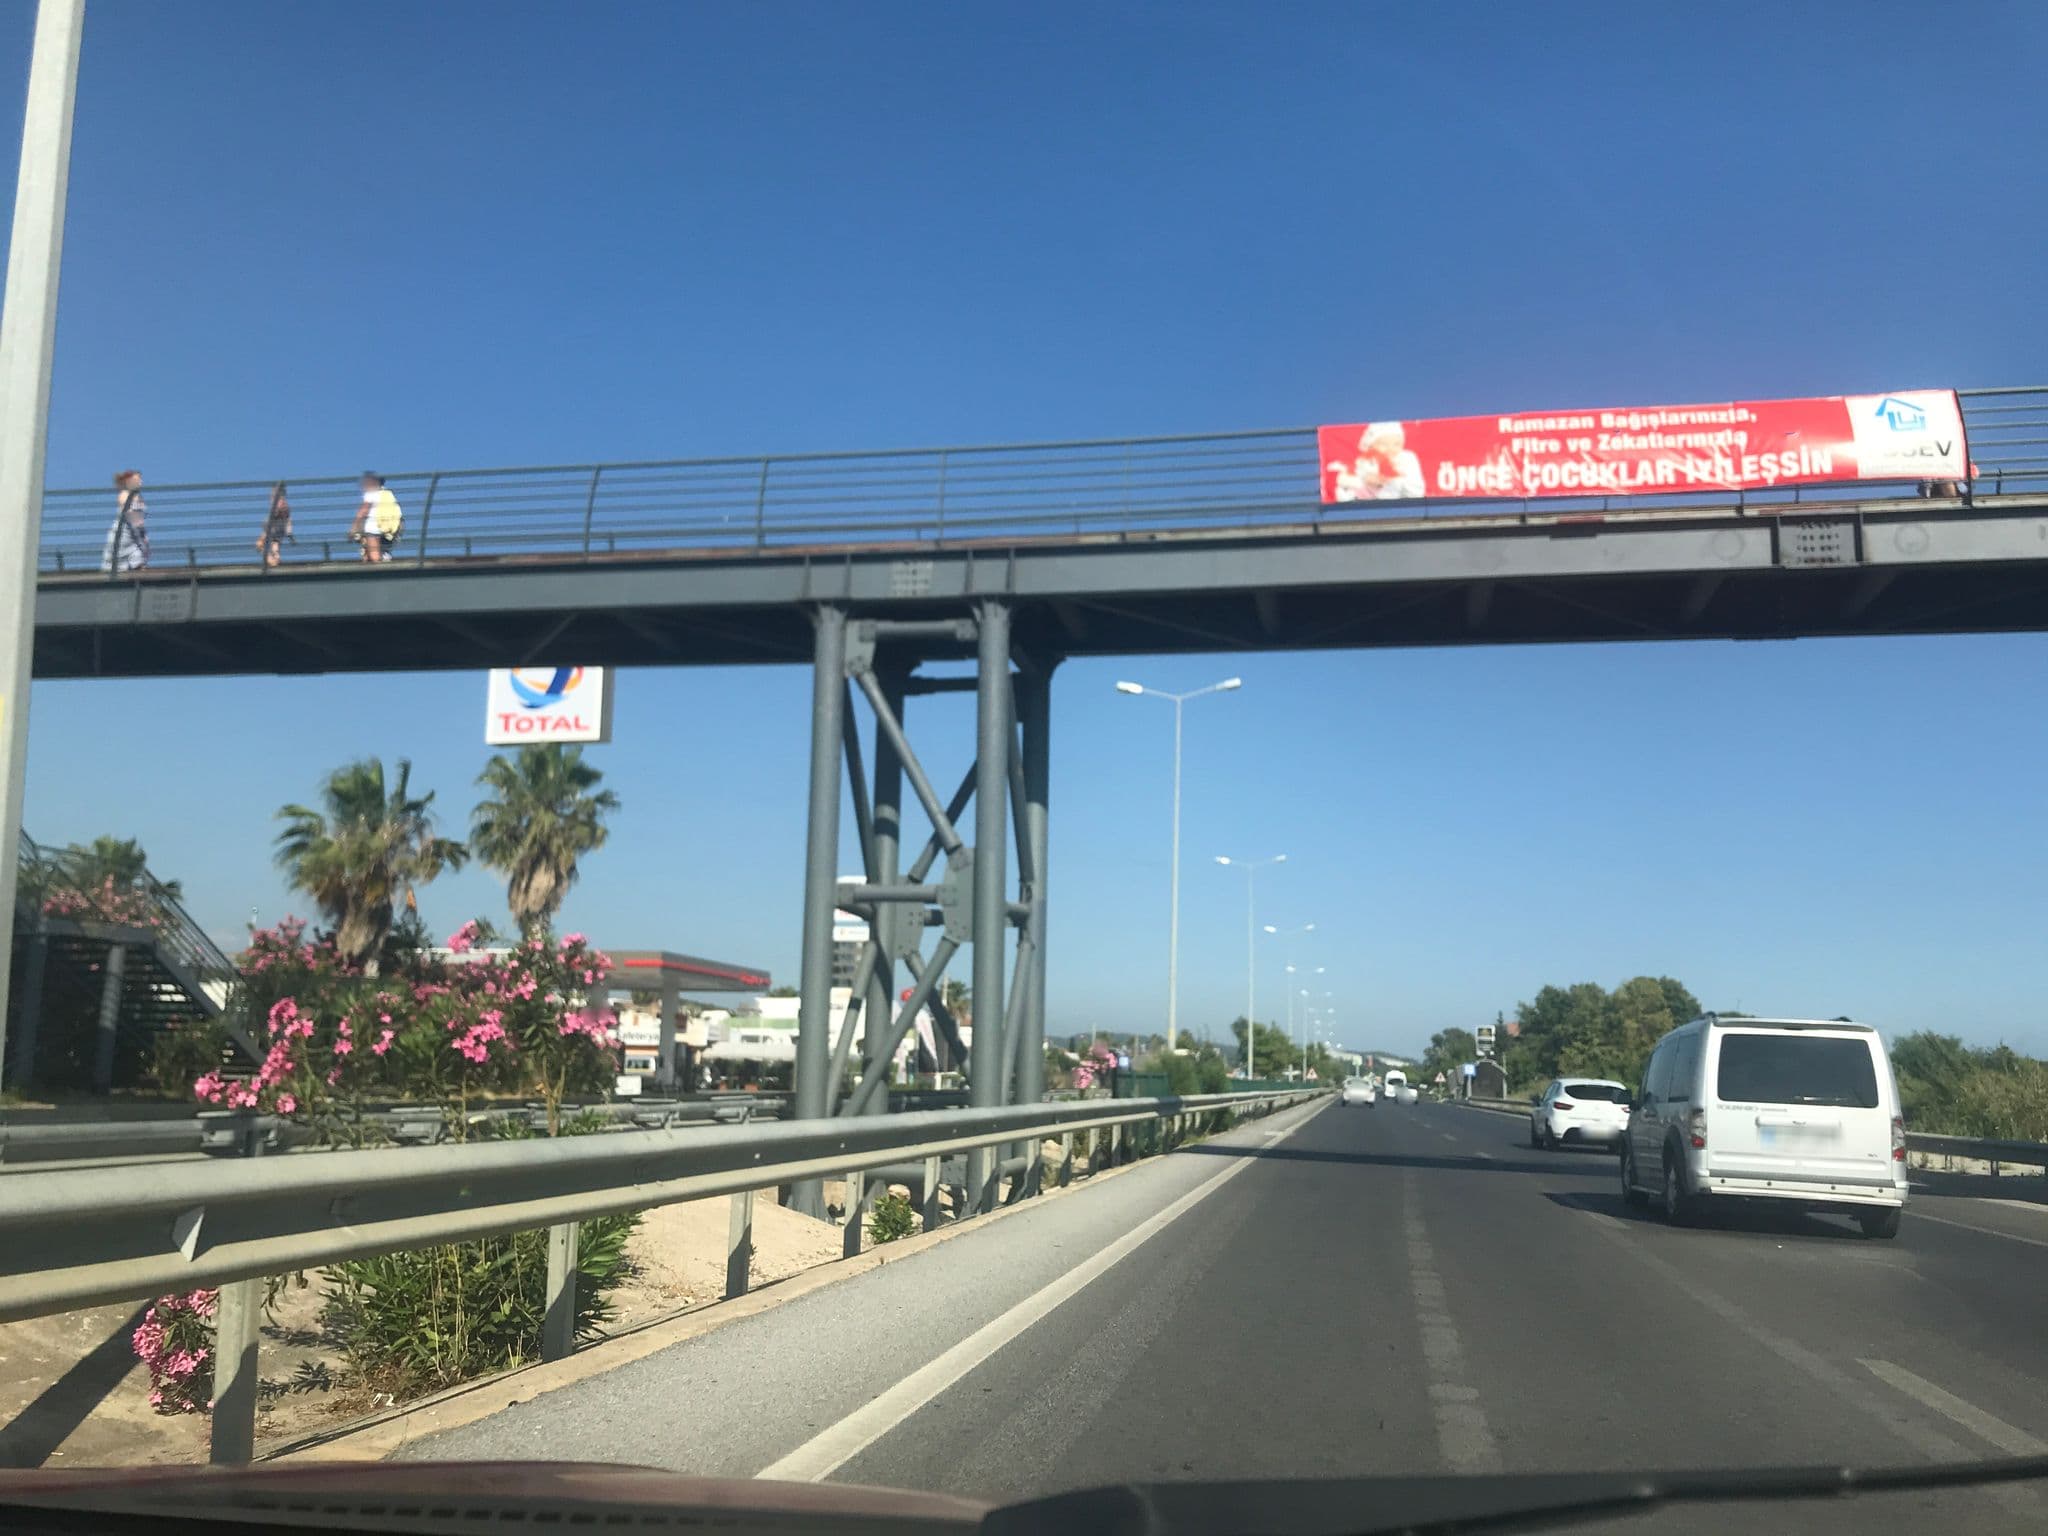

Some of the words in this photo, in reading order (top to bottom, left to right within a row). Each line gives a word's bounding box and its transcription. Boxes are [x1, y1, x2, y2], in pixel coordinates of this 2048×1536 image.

[1498, 416, 1594, 433] Ramazan
[1601, 408, 1757, 430] Bağışlarınızla,
[1512, 437, 1561, 454] Fitre
[1566, 437, 1593, 453] ve
[1437, 461, 1514, 491] ÖNCE
[1523, 457, 1676, 495] ÇOCUKLAR
[498, 712, 590, 734] TOTAL
